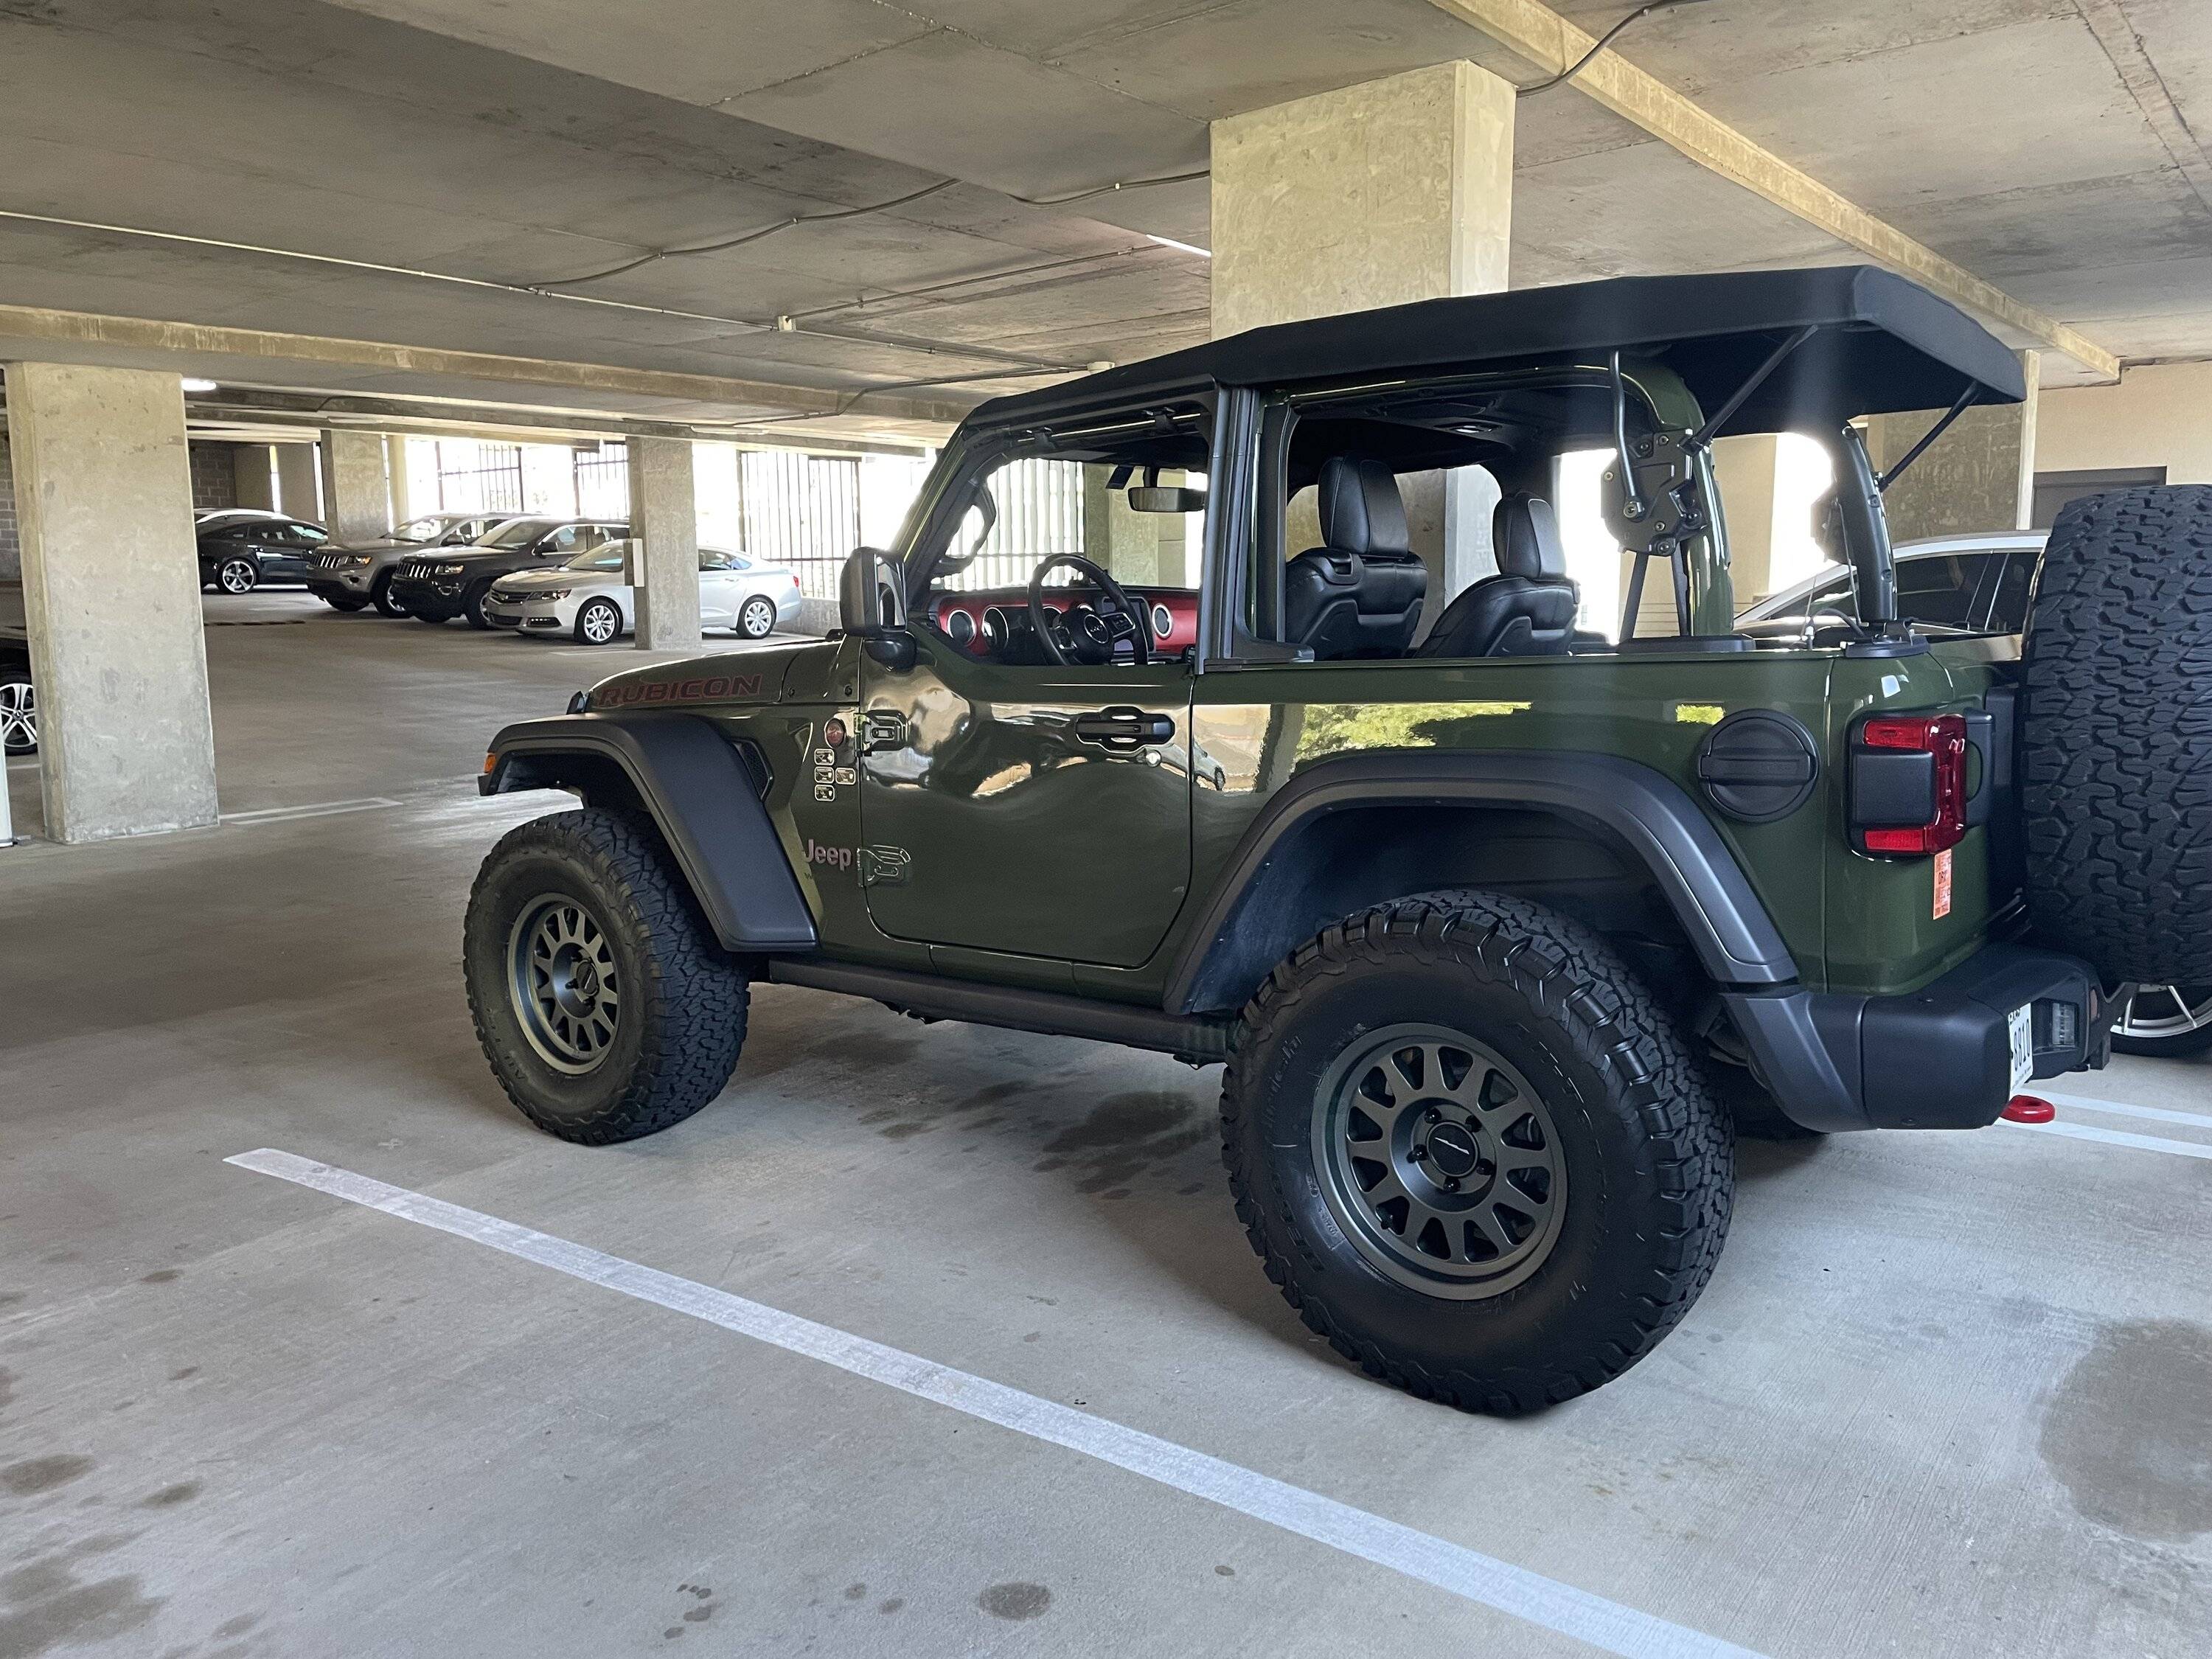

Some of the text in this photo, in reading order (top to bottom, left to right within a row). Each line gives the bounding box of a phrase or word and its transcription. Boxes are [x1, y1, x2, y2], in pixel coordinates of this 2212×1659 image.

[597, 674, 762, 707] RUBICON
[802, 839, 852, 871] Jeep
[2014, 1018, 2030, 1071] 8810
